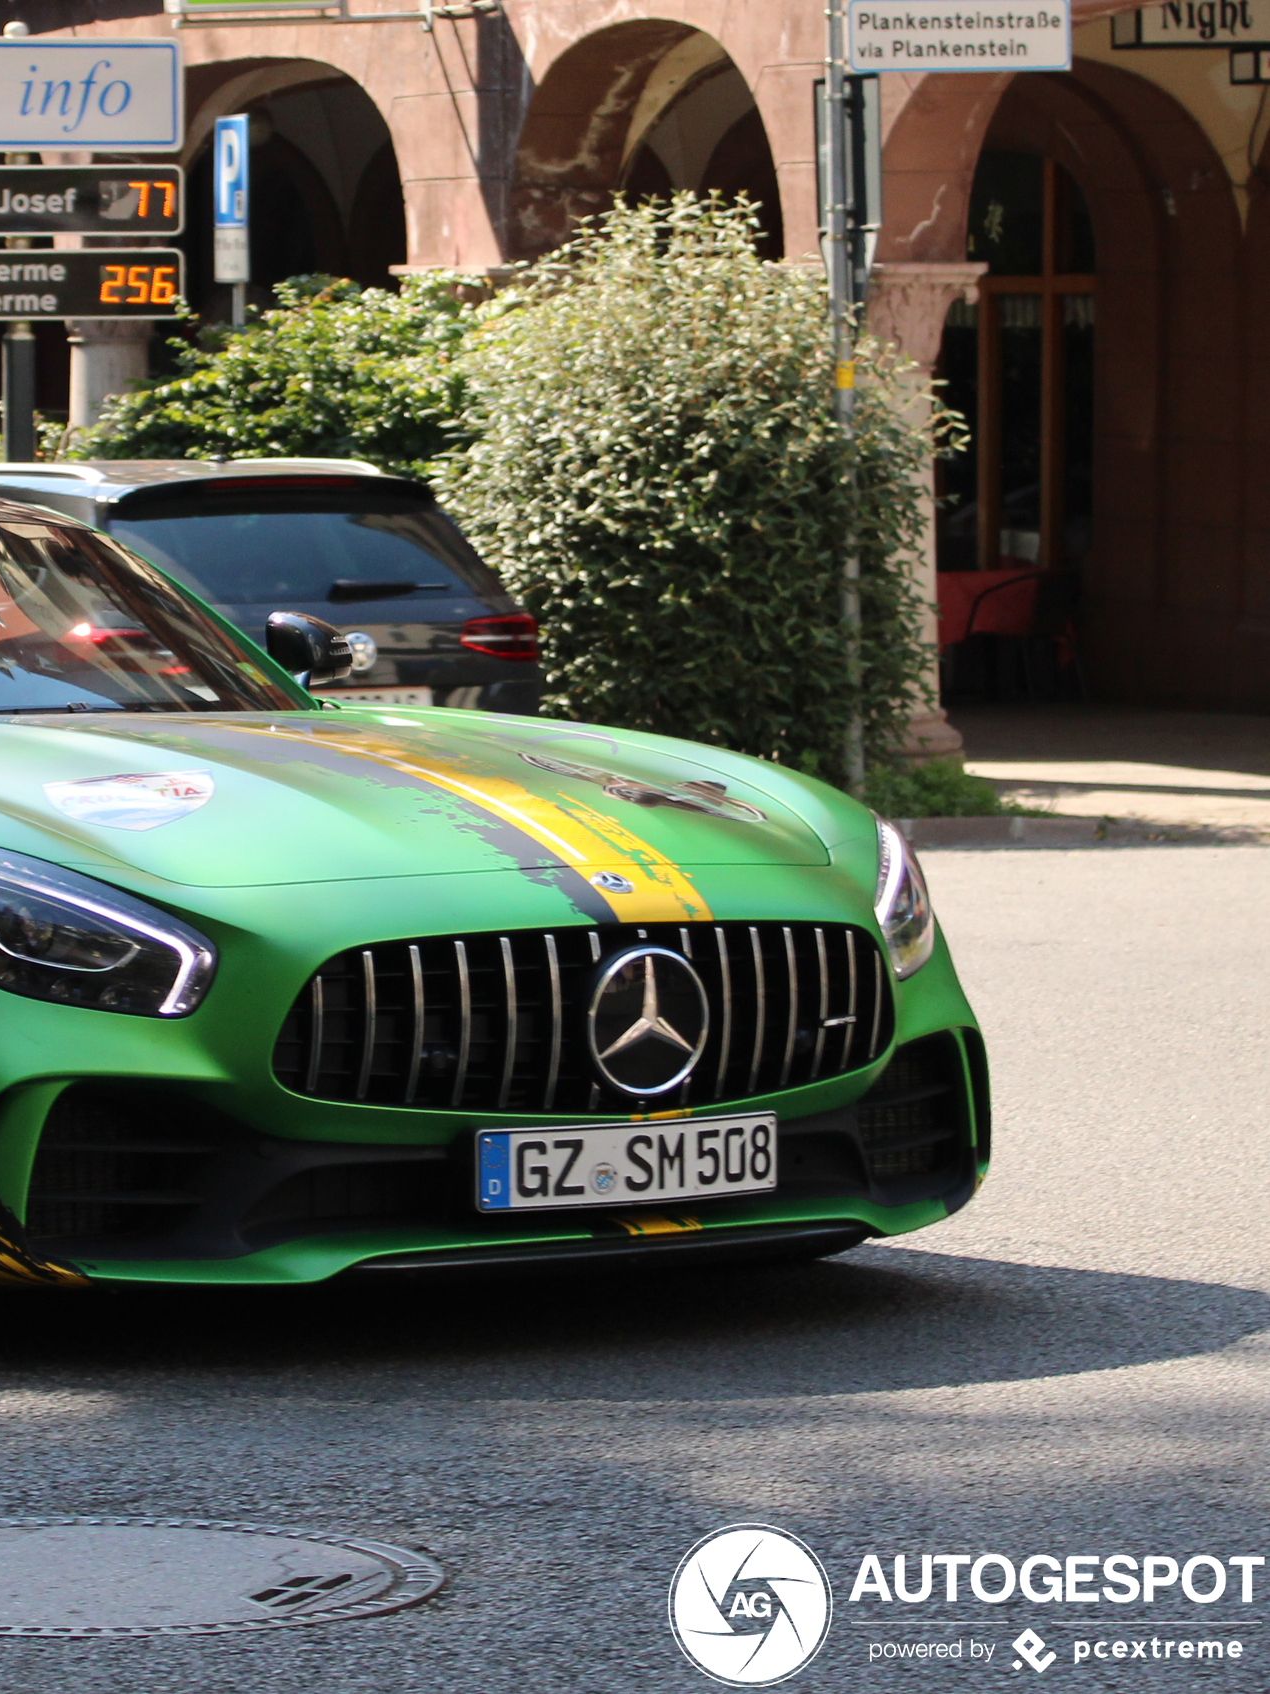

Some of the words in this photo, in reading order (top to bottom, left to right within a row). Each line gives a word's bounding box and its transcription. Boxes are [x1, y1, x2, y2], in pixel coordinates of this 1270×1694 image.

[858, 12, 1062, 31] Plankensteinstraße
[1161, 0, 1254, 39] Night
[858, 43, 884, 58] via
[892, 39, 1028, 58] Plankenstein
[18, 61, 133, 132] info
[220, 129, 240, 214] P
[128, 181, 175, 218] 77
[100, 265, 176, 304] 256
[61, 786, 202, 807] CROTIA
[515, 1139, 585, 1198] GZ
[697, 1124, 772, 1185] 508
[488, 1178, 502, 1196] D
